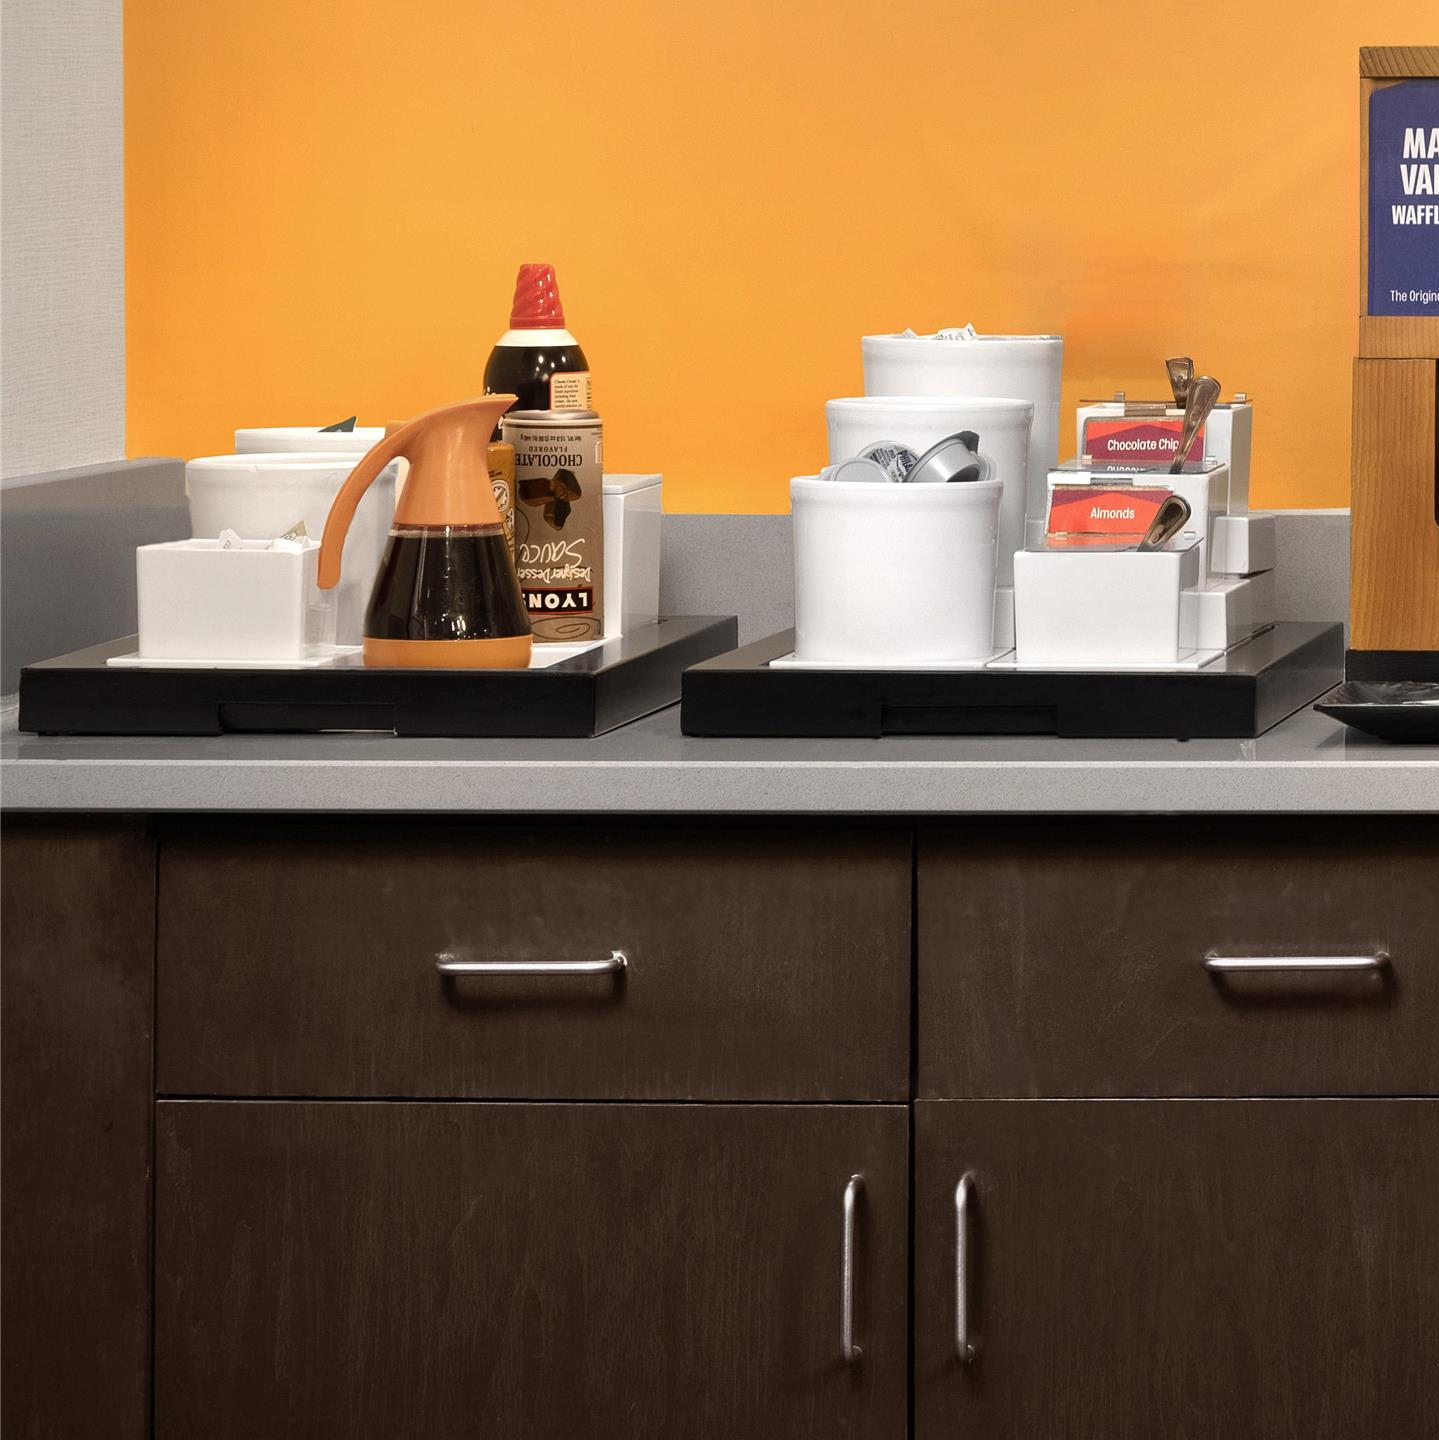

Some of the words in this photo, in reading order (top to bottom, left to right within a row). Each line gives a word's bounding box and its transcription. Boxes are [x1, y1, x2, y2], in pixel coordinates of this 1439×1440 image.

[1390, 289, 1408, 302] The
[1107, 438, 1158, 451] Chocolate
[1158, 438, 1180, 453] Chip
[515, 453, 583, 467] CHOCOLATE
[1090, 506, 1136, 520] Almonds
[520, 538, 585, 568] Sauce
[518, 567, 551, 583] Desser
